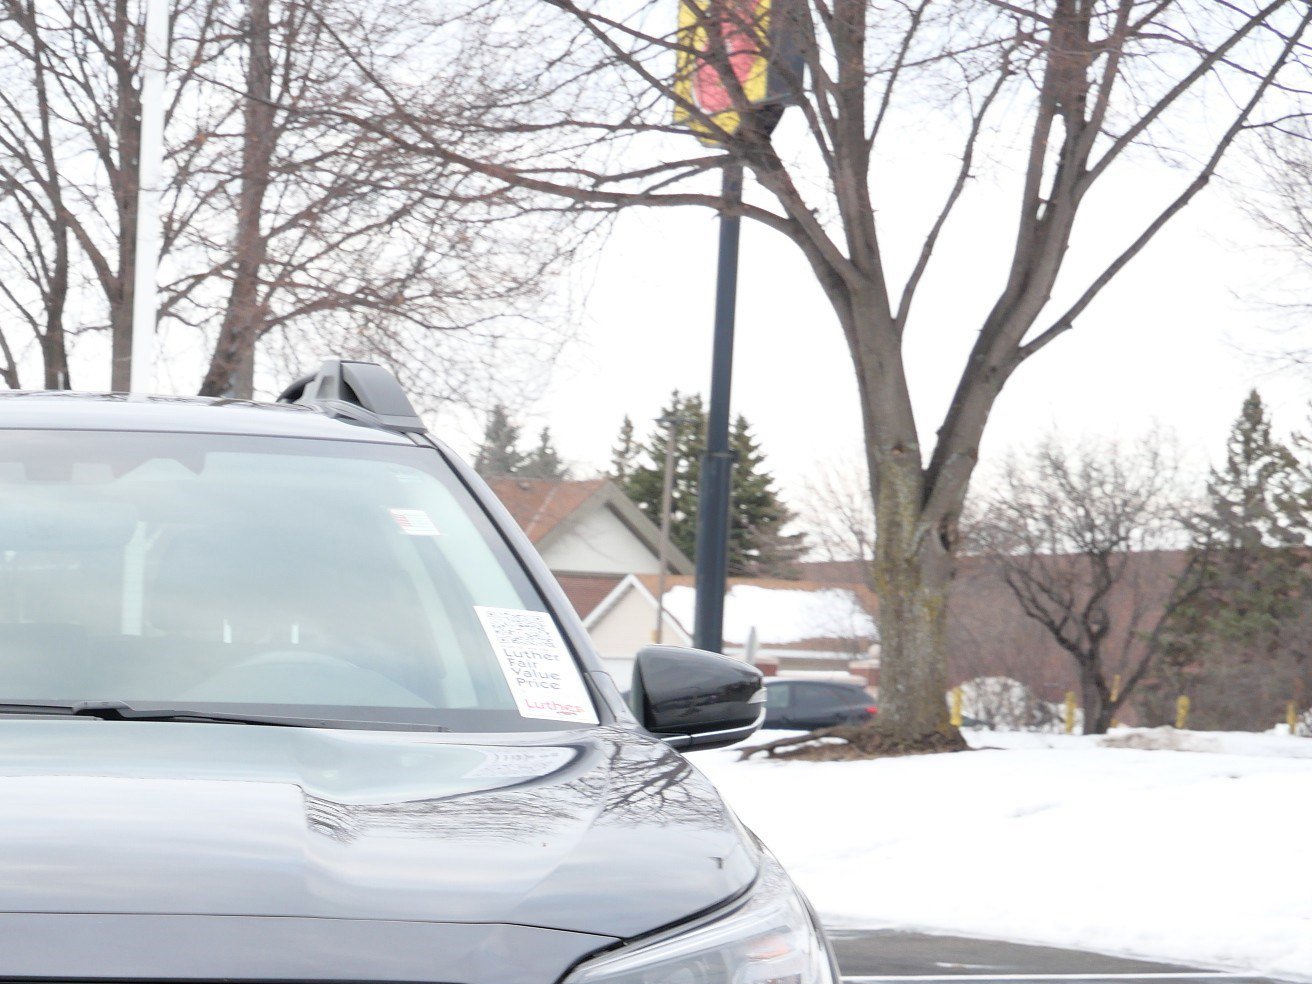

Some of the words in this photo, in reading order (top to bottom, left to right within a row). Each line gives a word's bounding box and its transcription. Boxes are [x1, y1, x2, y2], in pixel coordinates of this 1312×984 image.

[507, 657, 537, 669] Fair
[510, 667, 561, 680] Value
[516, 677, 560, 690] Price
